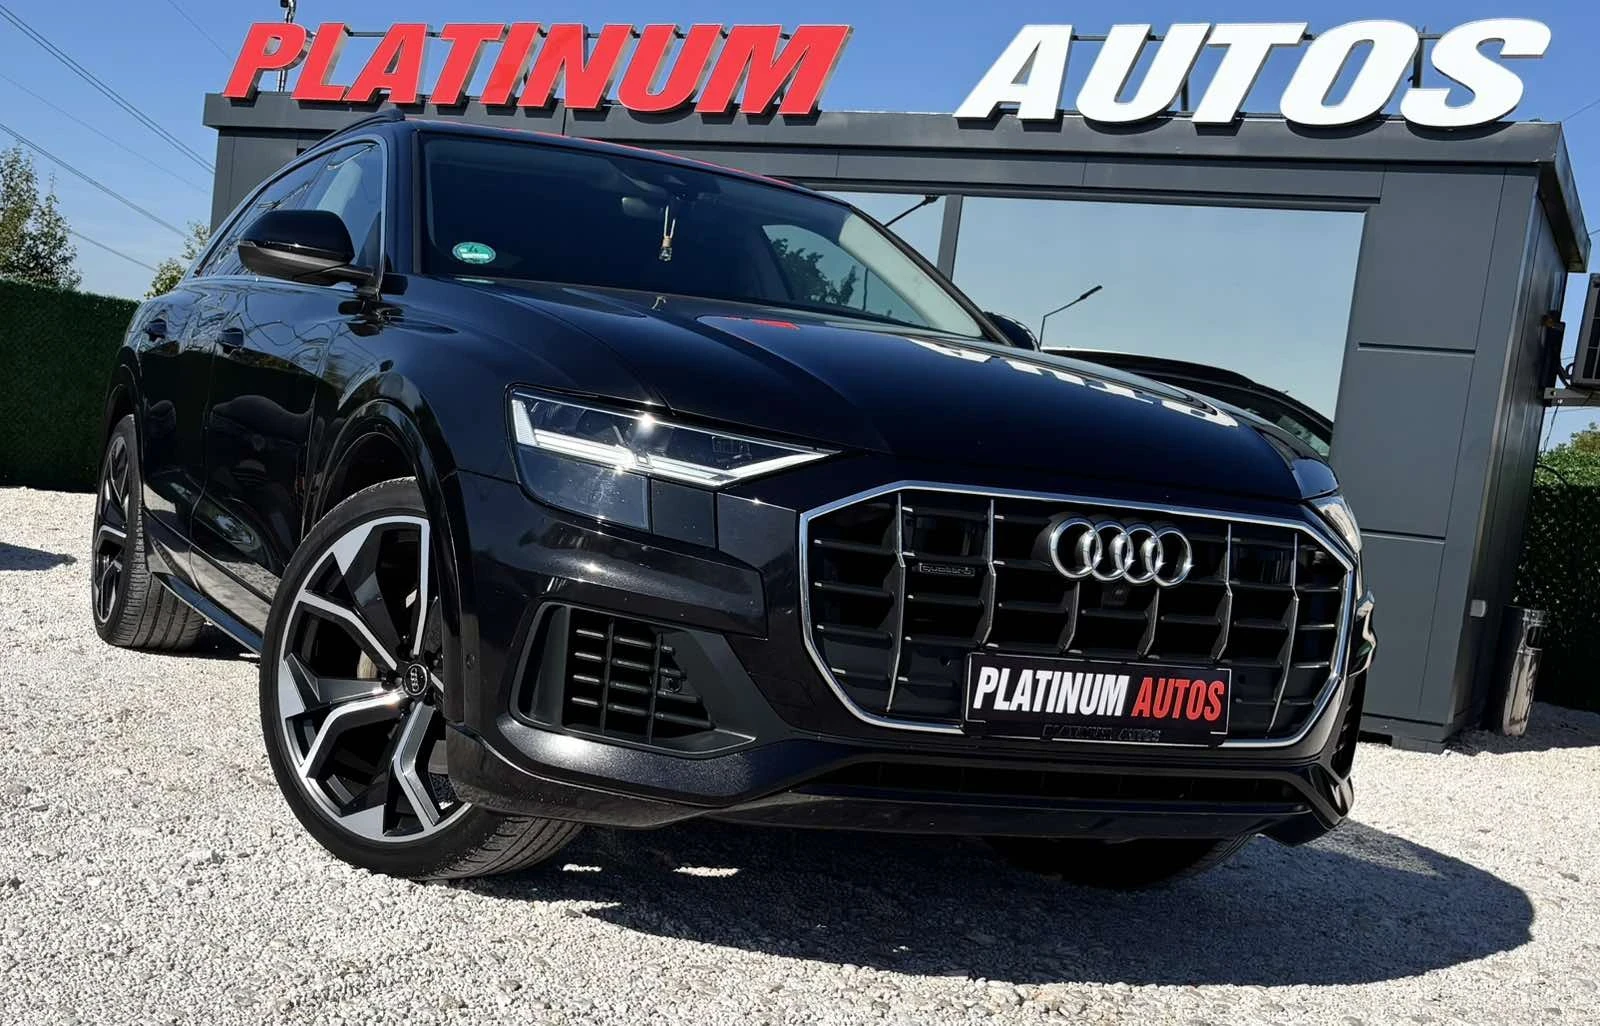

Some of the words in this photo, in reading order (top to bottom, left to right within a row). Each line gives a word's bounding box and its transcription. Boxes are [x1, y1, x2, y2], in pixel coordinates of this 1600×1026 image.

[222, 22, 851, 115] PLATINUM
[953, 18, 1552, 127] AUTOS
[973, 666, 1130, 717] PLATINUM
[1131, 676, 1225, 721] AUTOS
